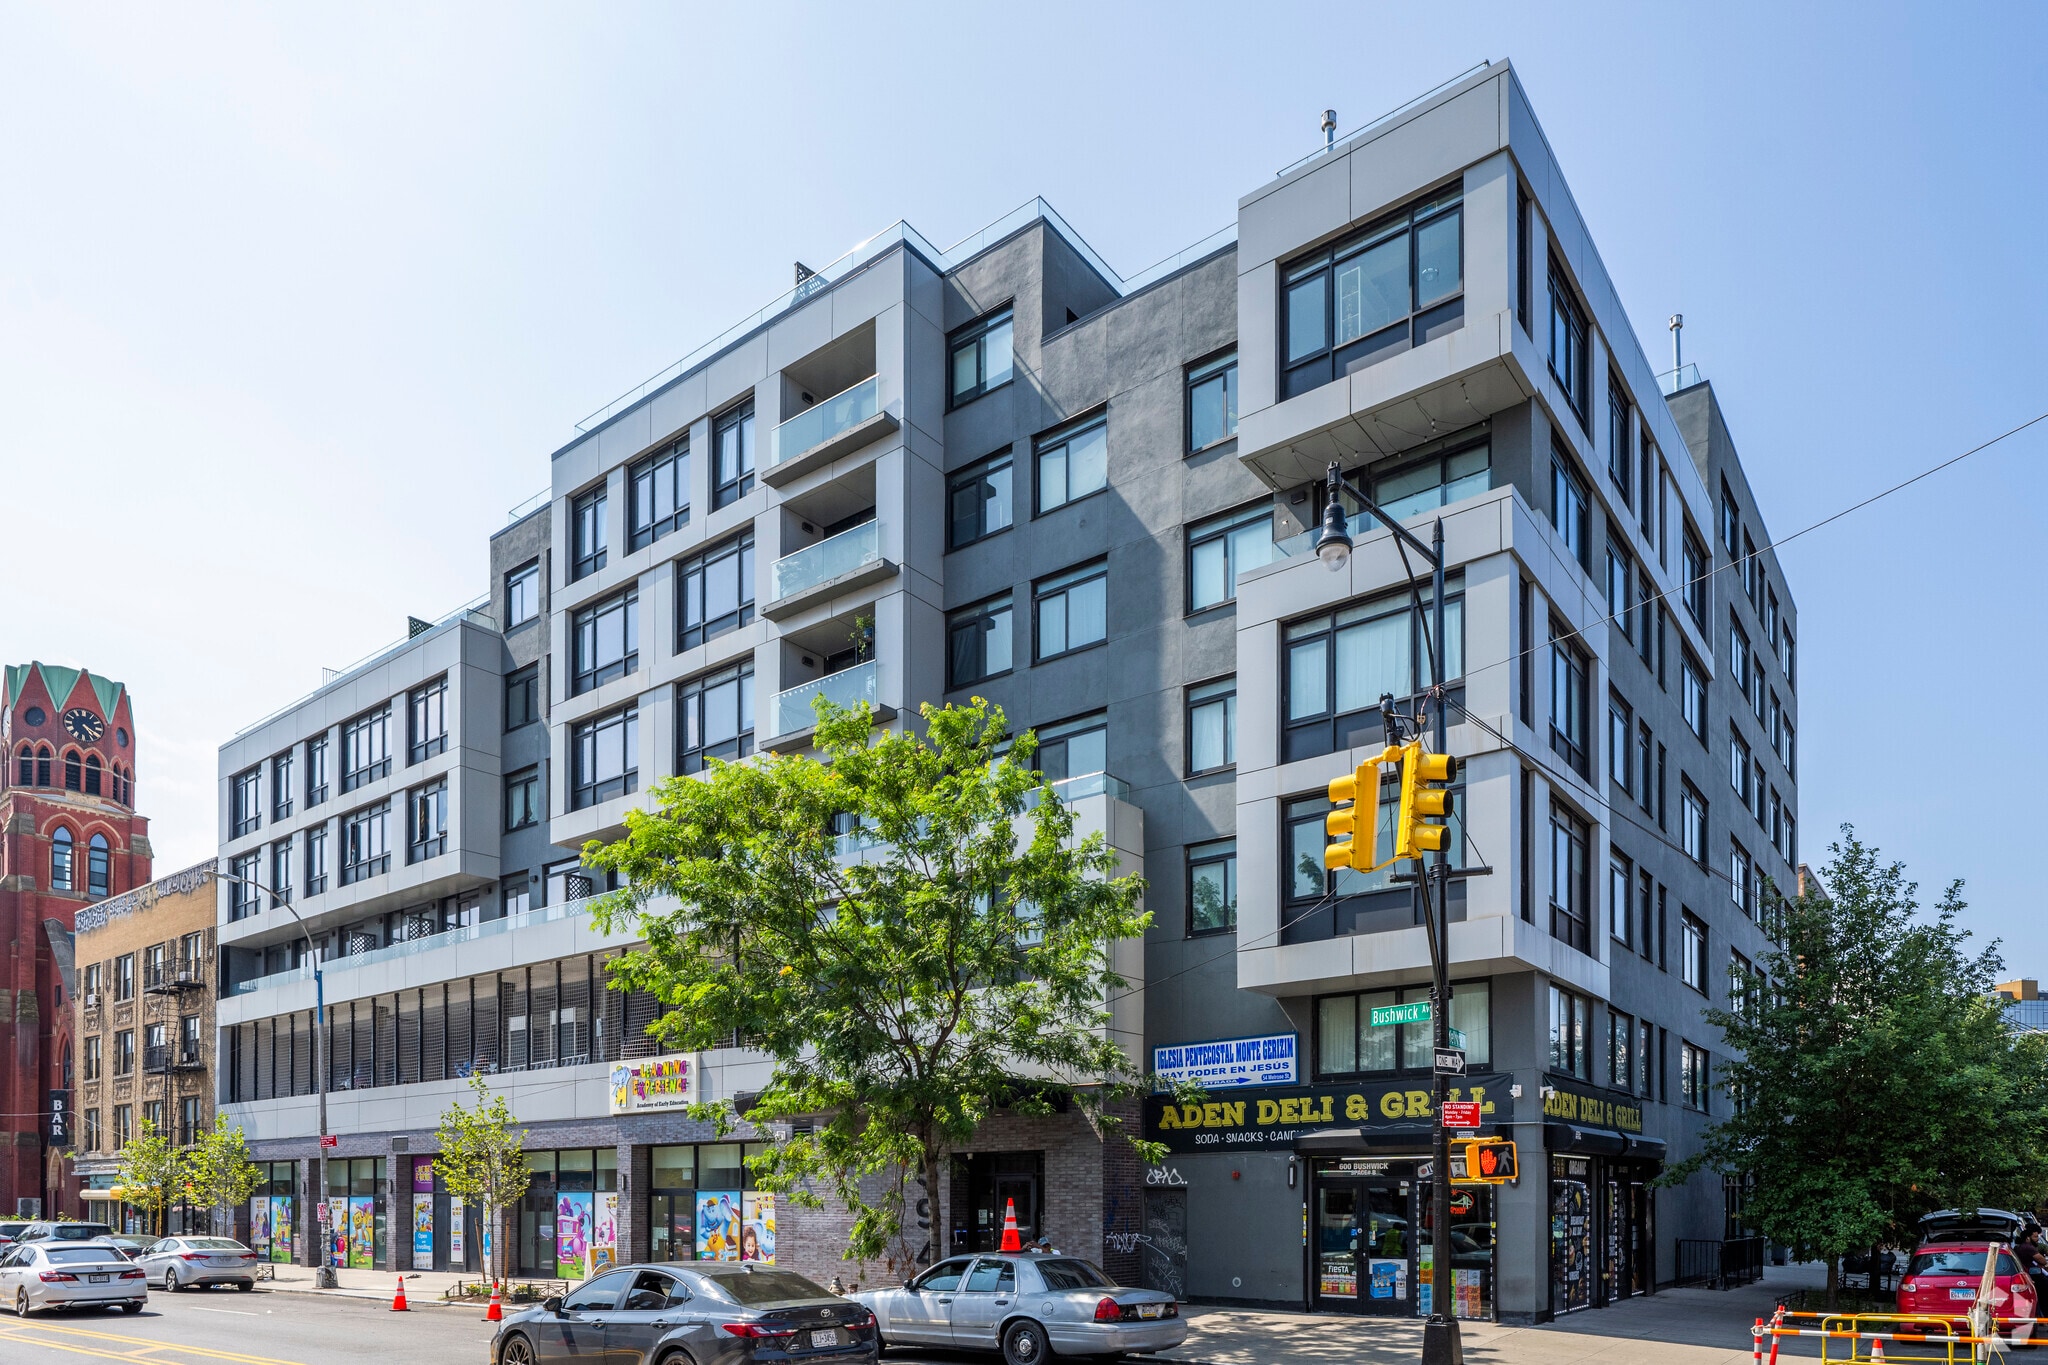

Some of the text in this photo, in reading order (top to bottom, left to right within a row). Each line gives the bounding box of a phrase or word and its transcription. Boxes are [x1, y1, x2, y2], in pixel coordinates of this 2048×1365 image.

[1373, 1006, 1418, 1024] Bushwick
[1157, 1037, 1294, 1070] IGLESIA PENTECOSTAL MONTE GERIZIM
[1438, 1055, 1462, 1068] ONE WAY
[640, 1059, 688, 1078] LEARNING
[1188, 1067, 1227, 1078] PODER
[1230, 1066, 1246, 1074] EN
[1250, 1061, 1290, 1072] JESÚS
[52, 1099, 63, 1135] BAR
[1158, 1101, 1246, 1130] ADEN
[1256, 1096, 1334, 1126] DELI
[1345, 1094, 1368, 1121] &
[1544, 1090, 1642, 1132] ADEN DELI & GRILL
[1195, 1133, 1220, 1144] SODA
[1226, 1131, 1264, 1143] SNACKS
[1339, 1162, 1389, 1170] 600 BUSHWICK
